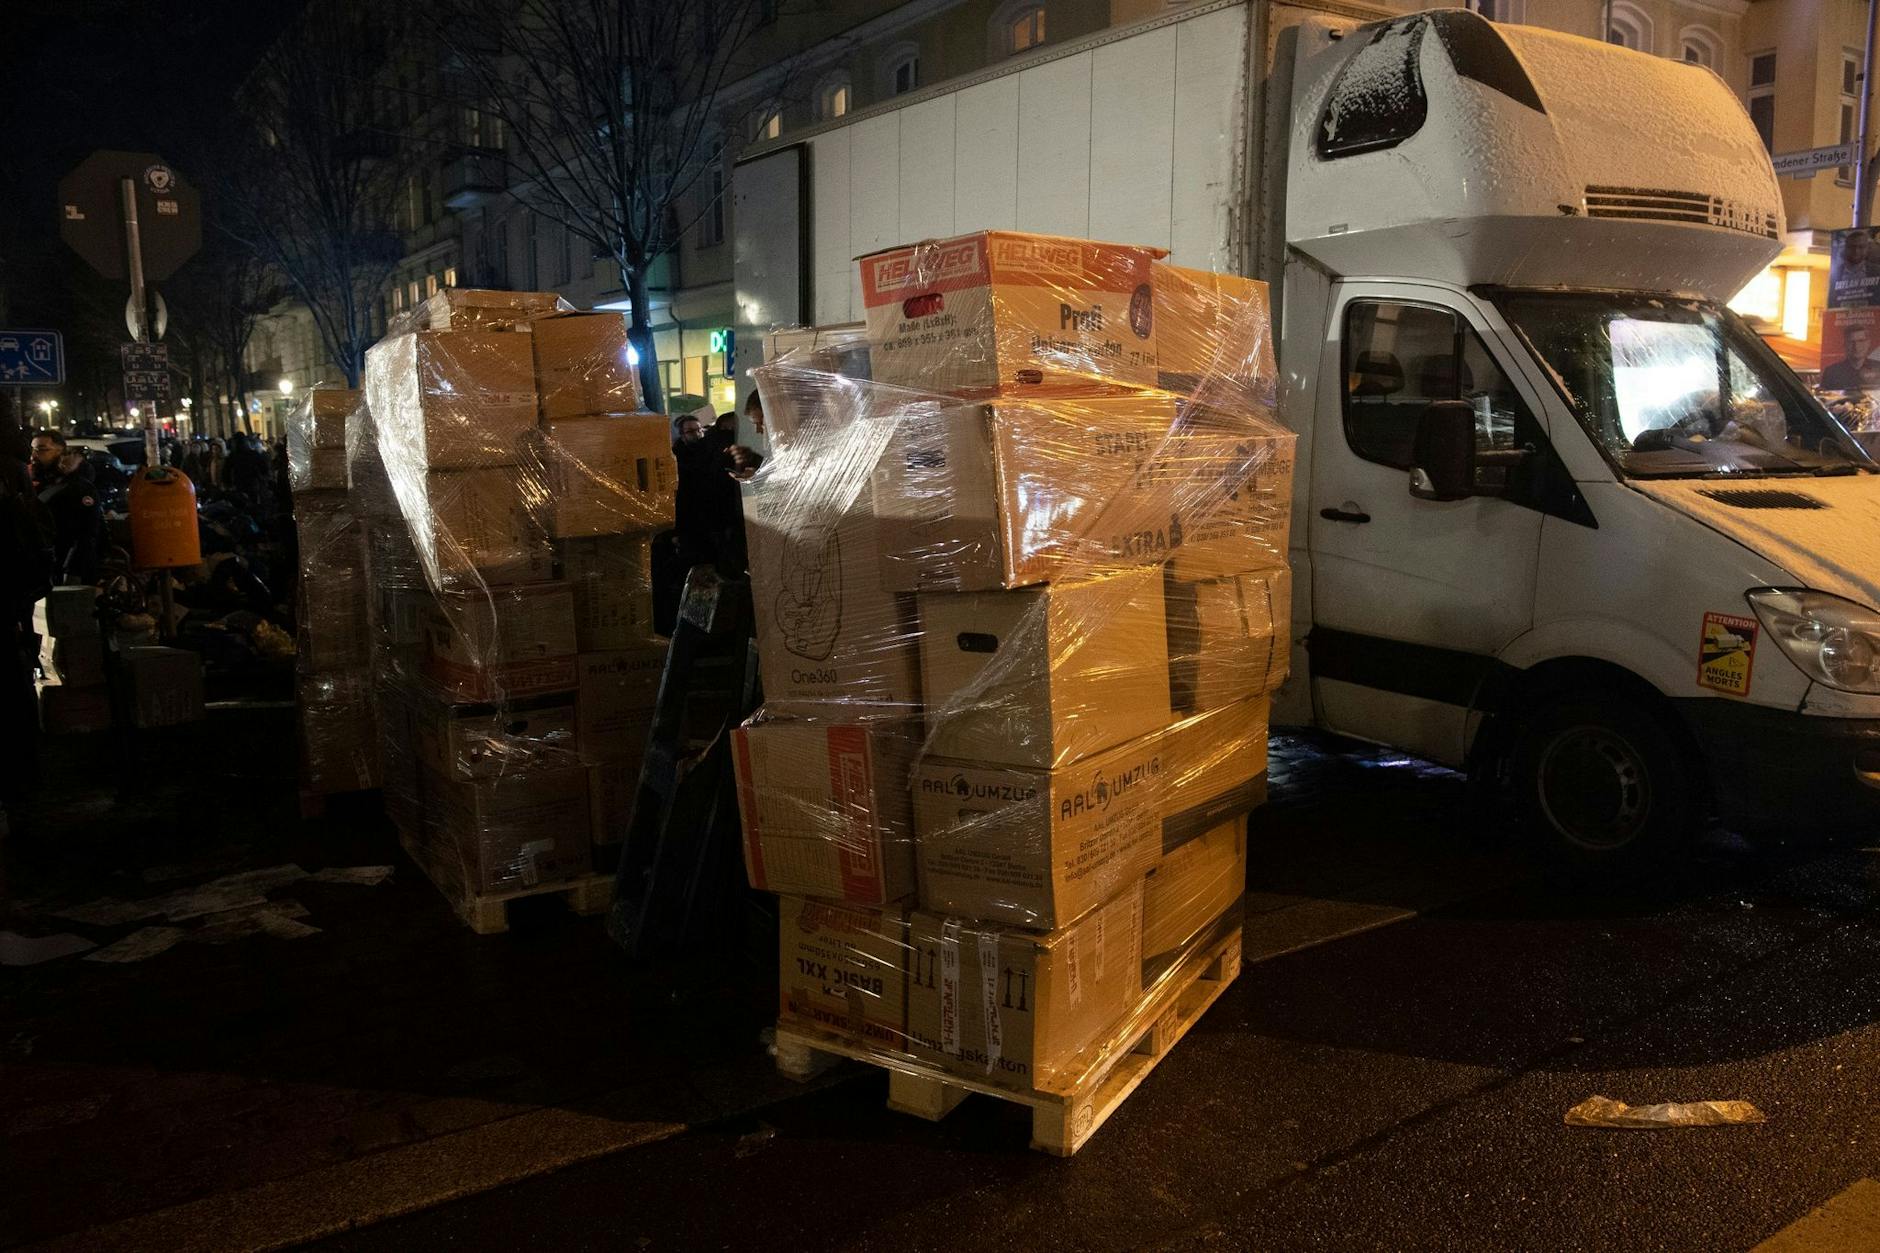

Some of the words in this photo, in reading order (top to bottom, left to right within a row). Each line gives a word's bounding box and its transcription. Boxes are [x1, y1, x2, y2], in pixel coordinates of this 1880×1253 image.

[1773, 157, 1808, 169] mdener
[1812, 150, 1847, 164] Straße
[1706, 613, 1757, 629] ATTENTION
[791, 668, 837, 684] One360
[1705, 666, 1743, 681] ANGLES
[1706, 675, 1741, 688] MORTS
[1112, 756, 1161, 796] UMZUG
[922, 779, 951, 795] AAL
[797, 957, 828, 980] XXL
[833, 968, 884, 996] BASIC
